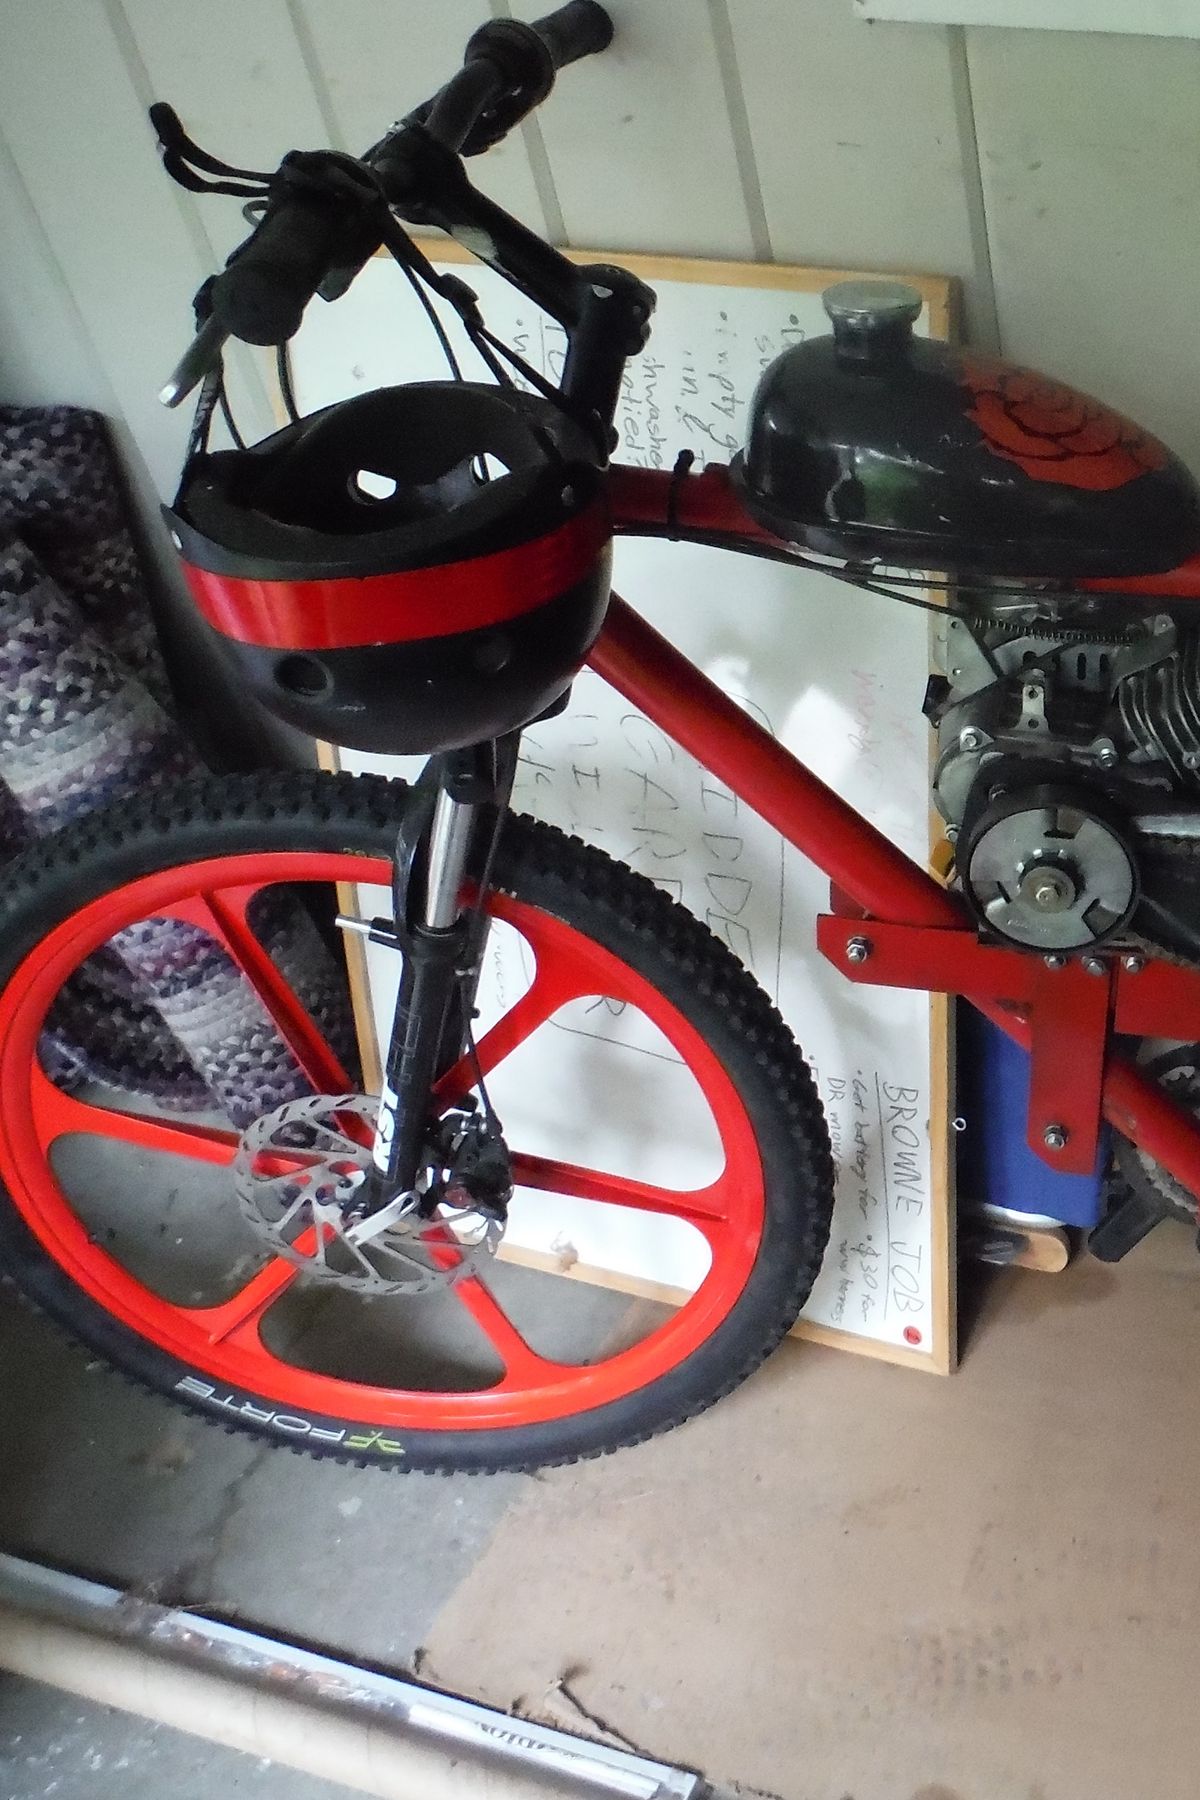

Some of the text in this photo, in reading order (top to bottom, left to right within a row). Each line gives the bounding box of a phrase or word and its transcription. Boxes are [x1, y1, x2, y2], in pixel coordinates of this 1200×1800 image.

[883, 1082, 926, 1217] BROWNE
[851, 1242, 881, 1290] $30
[890, 1241, 924, 1313] JOB
[174, 1376, 346, 1441] FORTE
